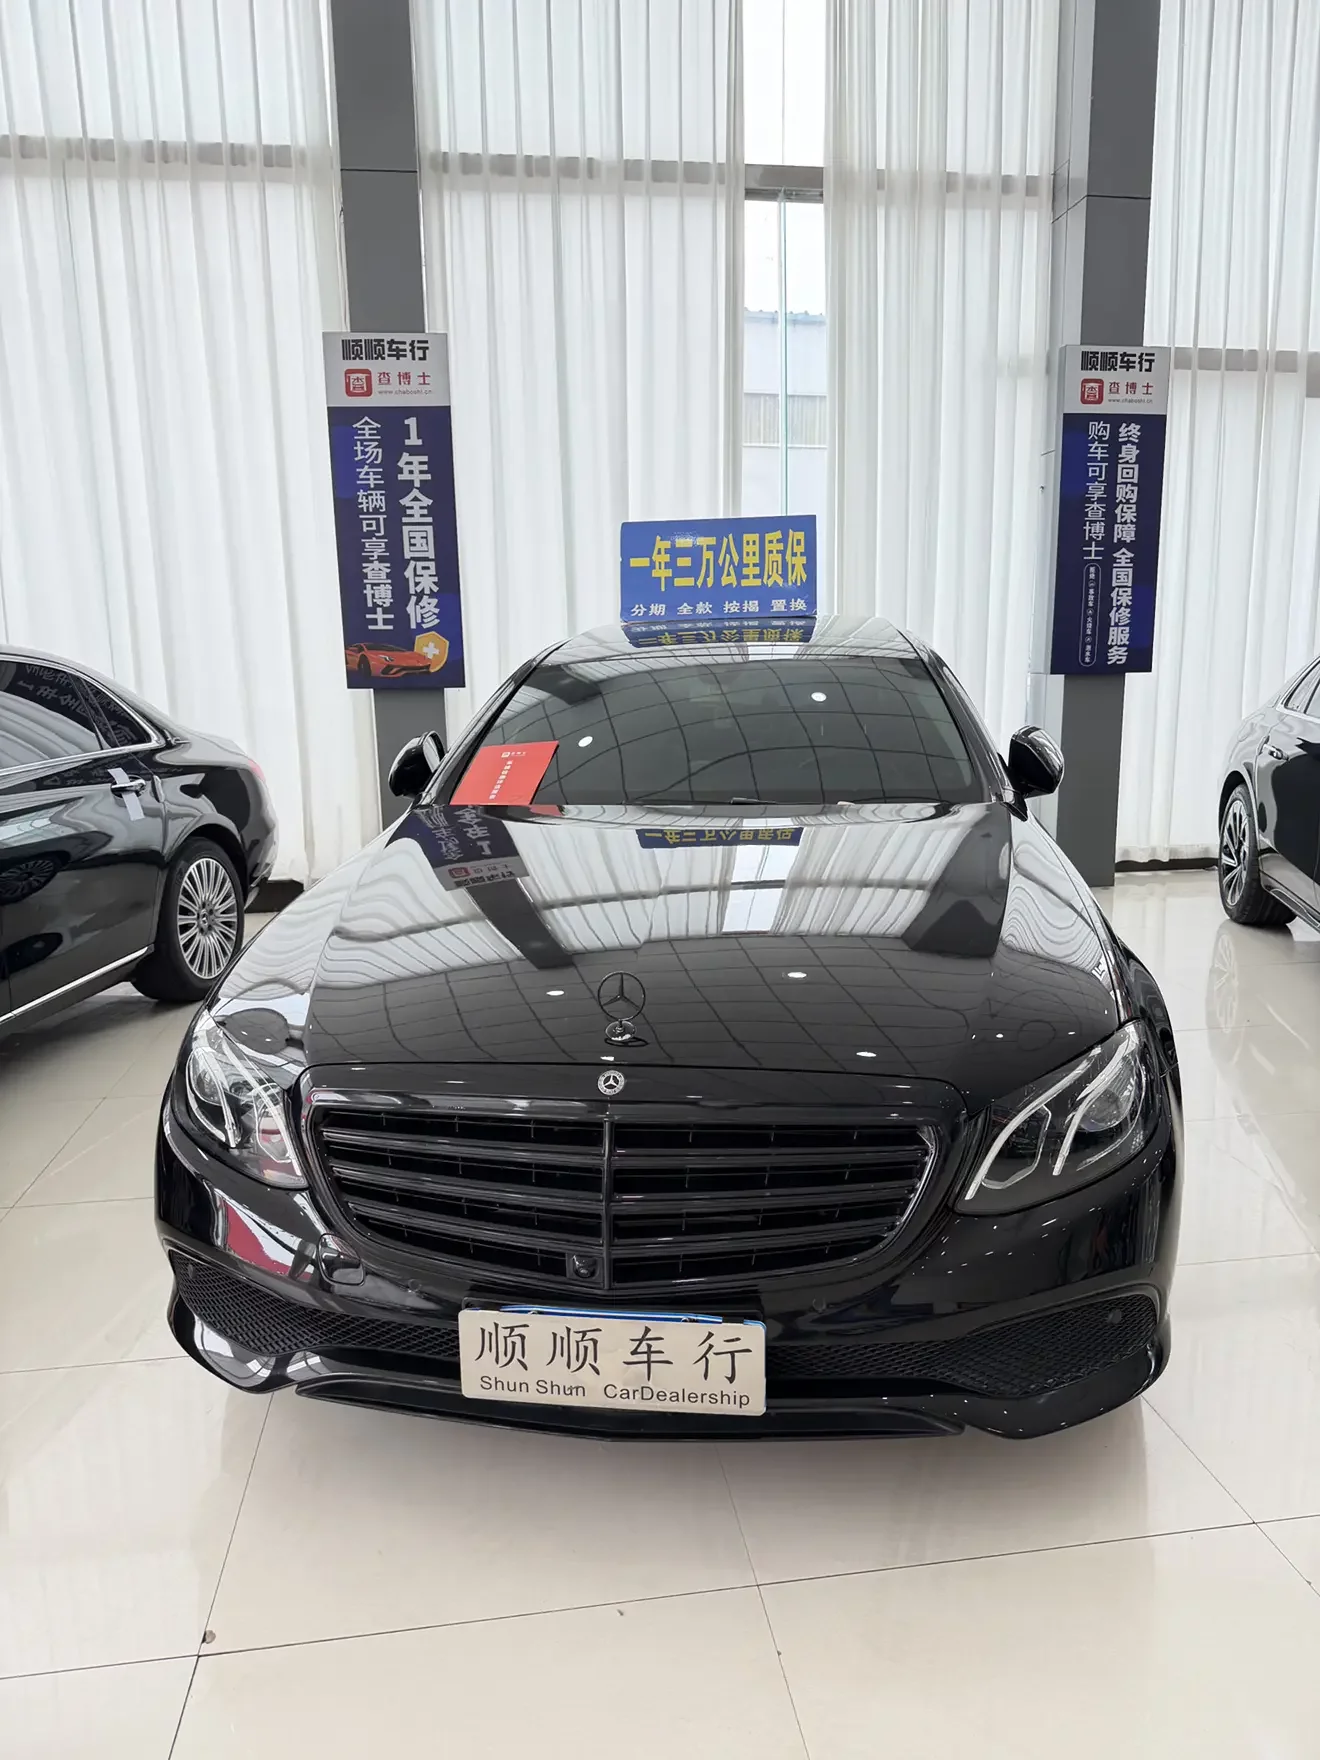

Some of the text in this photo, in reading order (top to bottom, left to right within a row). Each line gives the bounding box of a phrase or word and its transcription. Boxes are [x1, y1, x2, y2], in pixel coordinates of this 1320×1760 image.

[341, 339, 429, 361] 顺顺车行
[1081, 351, 1155, 373] 顺顺车行
[377, 371, 431, 386] 查博士
[1108, 381, 1154, 395] 查博士
[1082, 421, 1111, 560] 购车可享查博士
[352, 416, 394, 631] 全场车辆可享查博士
[397, 416, 441, 630] 1年全国保修
[1107, 423, 1141, 665] 终身回购保障 全国保修服务
[630, 529, 807, 592] 一年三万公里质保
[631, 598, 808, 617] 分期 全款 按揭 置换
[474, 1322, 752, 1384] 顺顺车行
[480, 1375, 751, 1409] Shun Shun CarDealership
